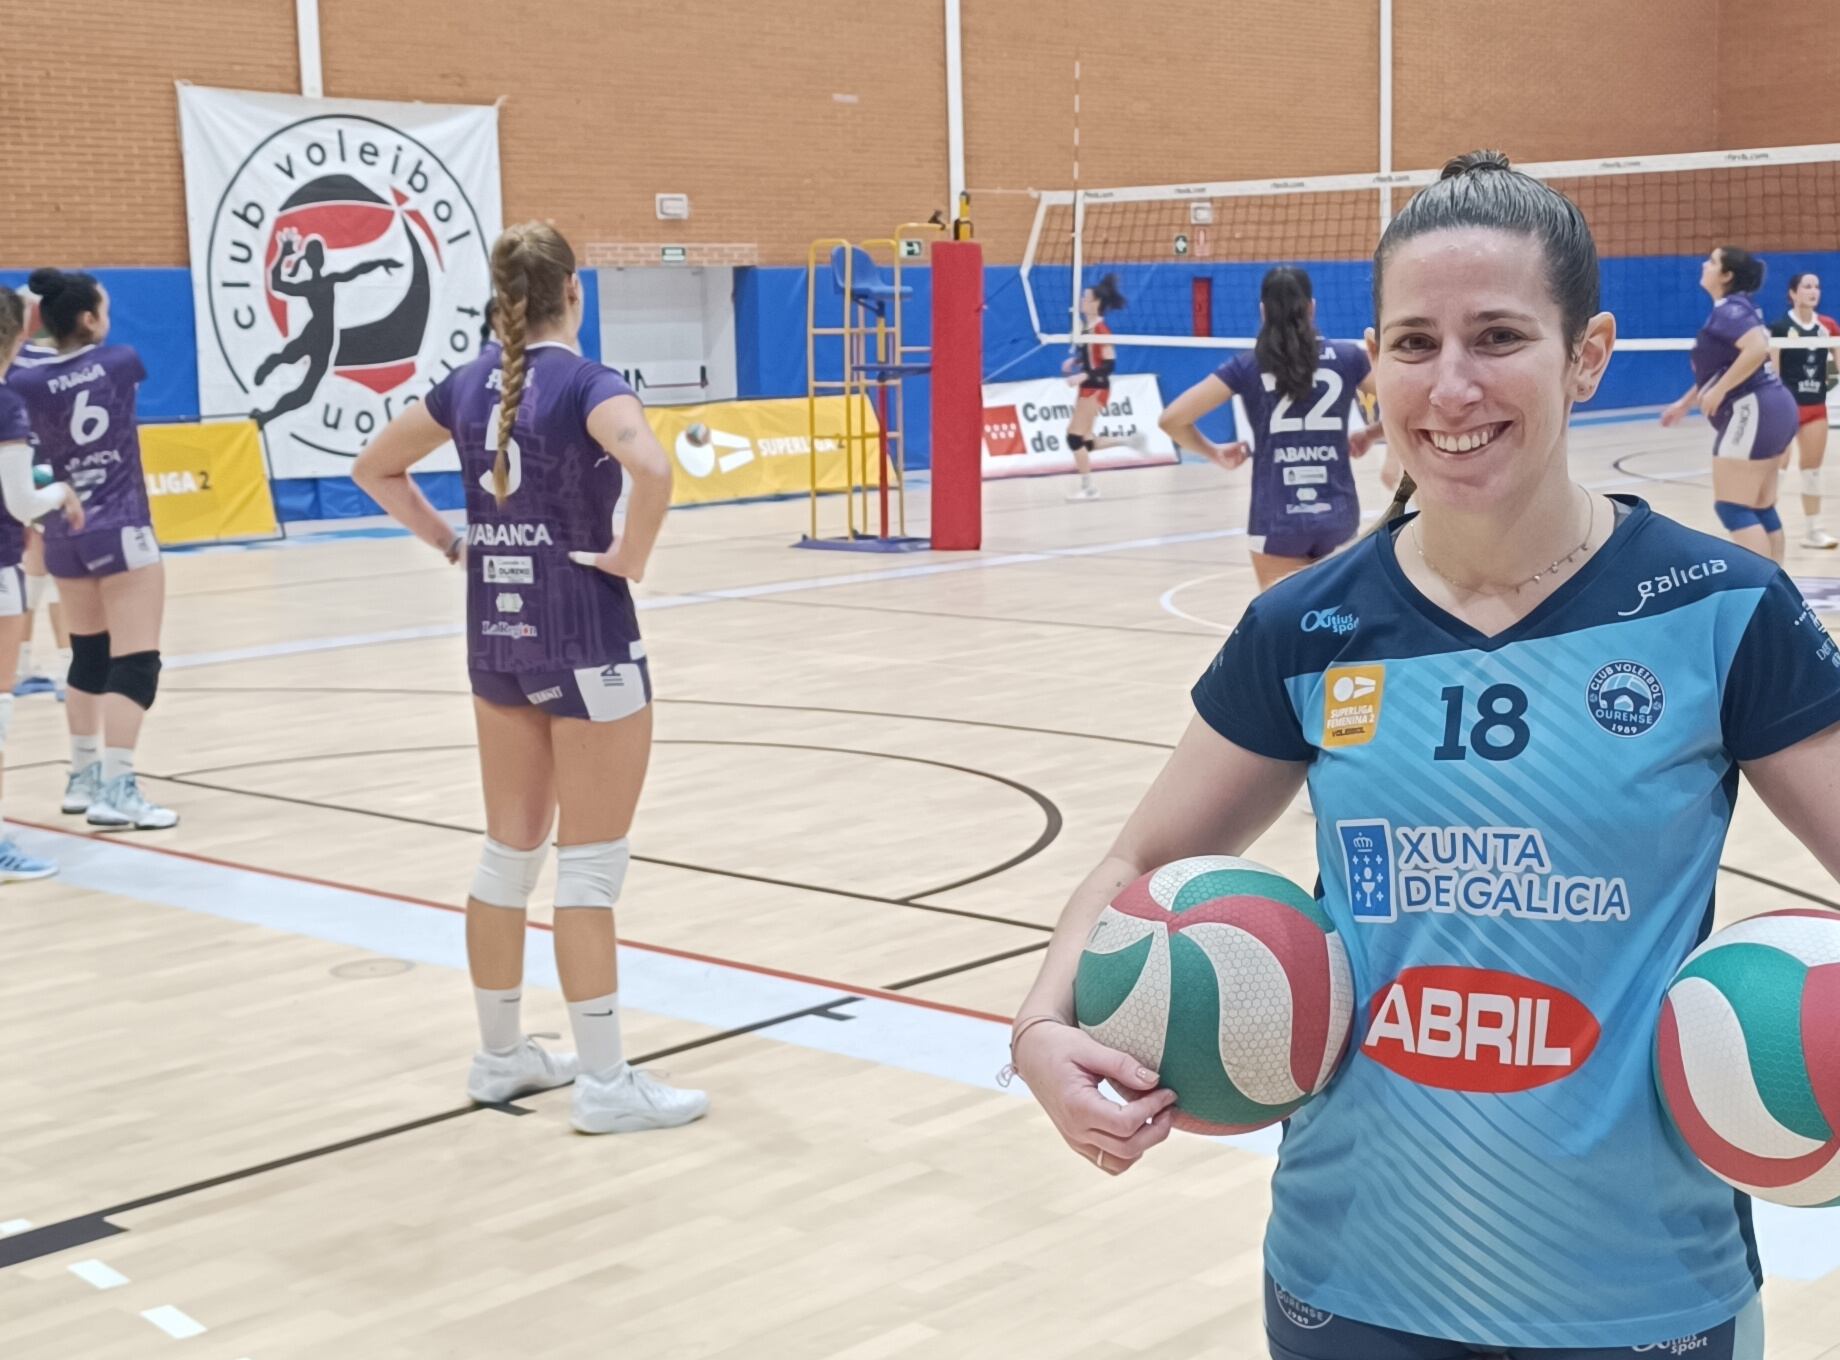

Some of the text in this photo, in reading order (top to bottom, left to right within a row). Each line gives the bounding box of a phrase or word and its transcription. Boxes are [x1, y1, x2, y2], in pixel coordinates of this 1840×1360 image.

[221, 201, 265, 330] club
[274, 129, 472, 245] voleibol
[1022, 396, 1134, 423] Comdad
[1261, 368, 1343, 434] 22
[70, 389, 110, 446] 6
[1031, 430, 1060, 453] de
[1275, 446, 1338, 463] ABANCA
[199, 470, 211, 490] 2
[474, 523, 553, 546] ABANCA
[1617, 559, 1728, 617] galicia
[1590, 663, 1662, 700] CLUB VOLEIBOL
[1330, 704, 1373, 719] SUPERLIGA
[1368, 713, 1376, 724] 2
[1433, 683, 1531, 761] 18
[1595, 708, 1653, 725] OURENSE
[1611, 723, 1638, 734] 1989
[1400, 830, 1546, 869] XUNTA
[1403, 874, 1628, 917] DE GALICIA
[1364, 983, 1572, 1067] ABRIL
[1670, 1336, 1708, 1356] sport
